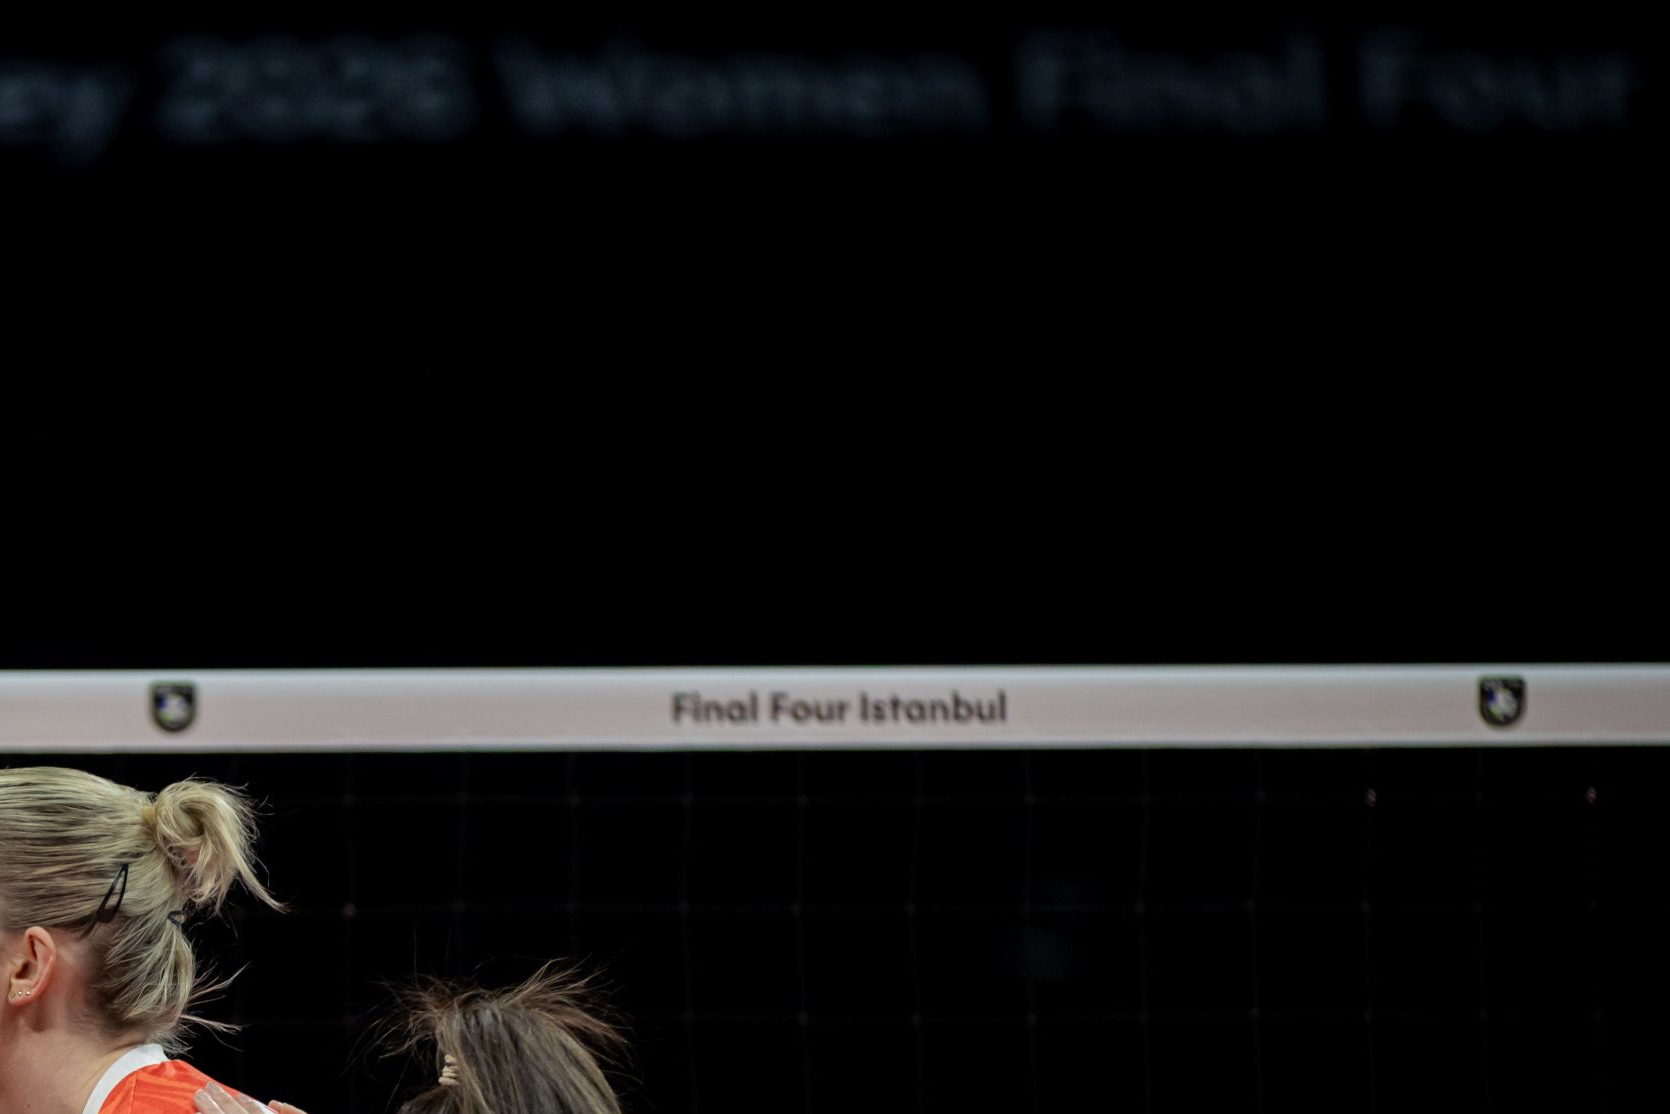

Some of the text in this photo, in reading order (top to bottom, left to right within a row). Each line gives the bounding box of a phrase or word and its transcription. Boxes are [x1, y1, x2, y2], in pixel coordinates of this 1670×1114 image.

[159, 35, 472, 140] 2026
[498, 38, 984, 134] Women
[1020, 34, 1321, 128] Final
[1362, 33, 1628, 125] Four
[671, 689, 1007, 723] Final Four Istanbul
